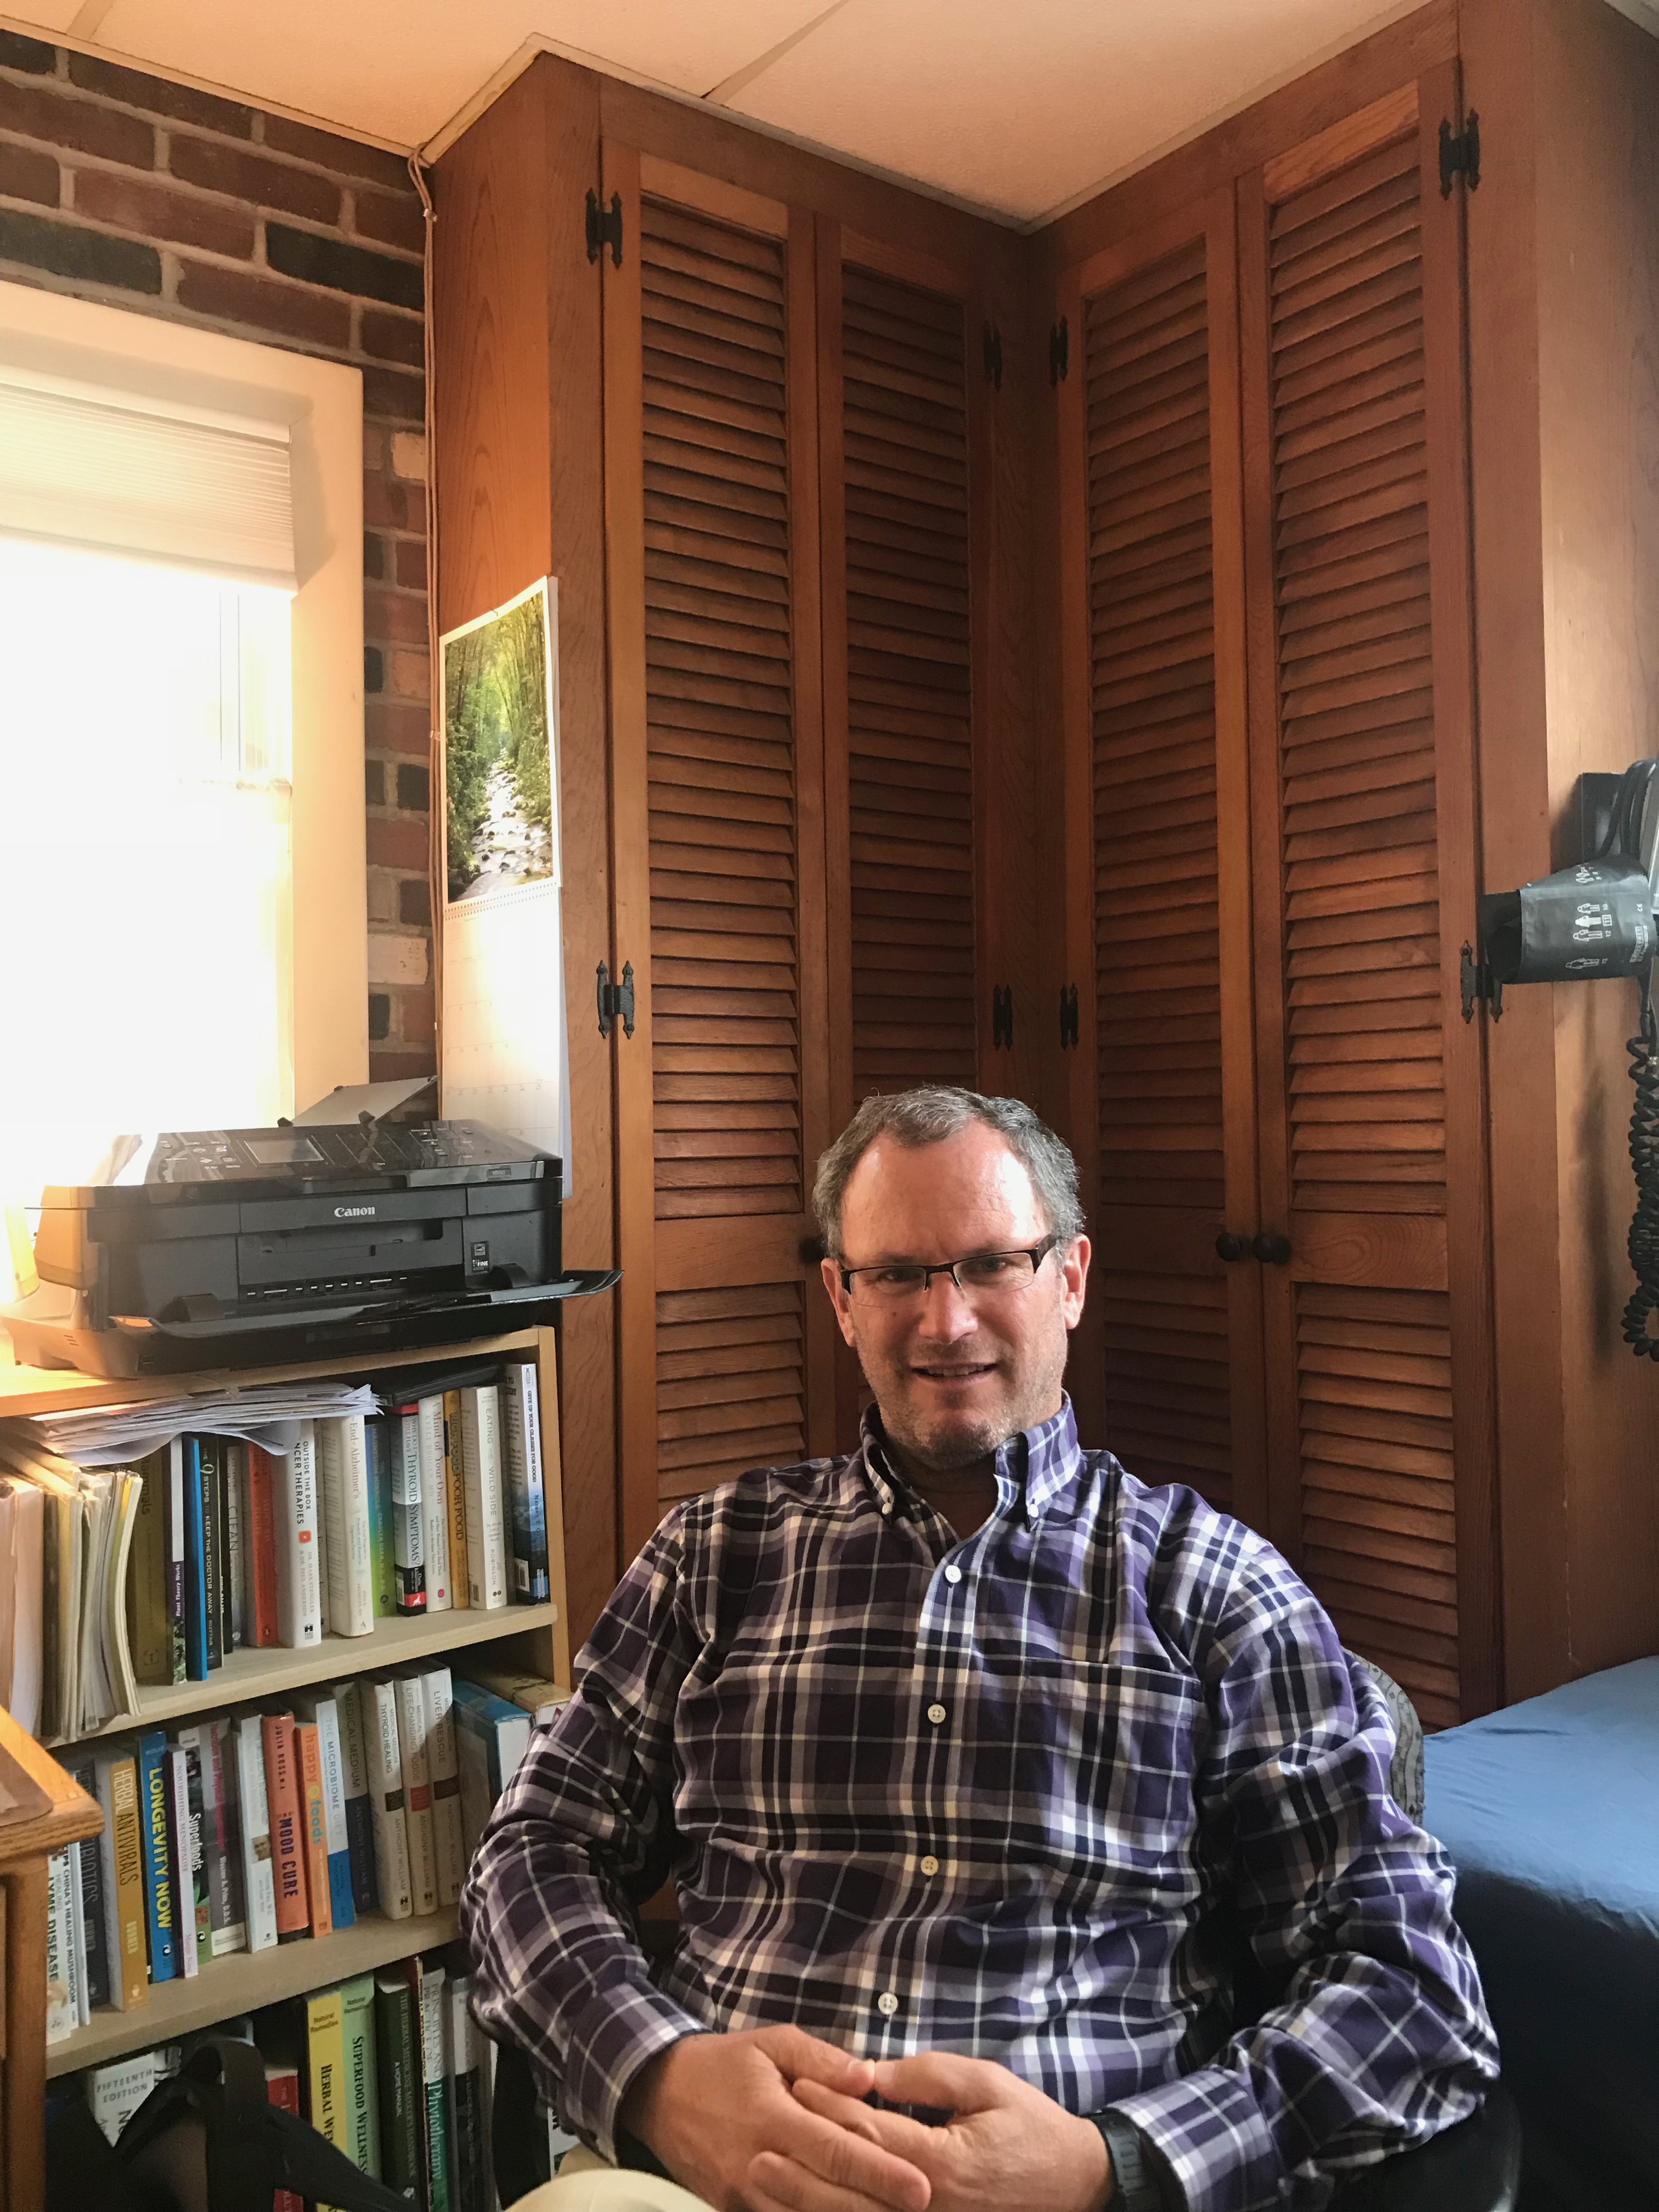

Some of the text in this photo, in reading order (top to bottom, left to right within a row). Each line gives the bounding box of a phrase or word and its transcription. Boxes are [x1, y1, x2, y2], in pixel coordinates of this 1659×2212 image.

[334, 1206, 375, 1217] Canon
[412, 1435, 418, 1446] DO
[433, 1412, 442, 1438] Mind
[434, 1441, 442, 1451] of
[449, 1412, 459, 1438] RICH
[199, 1463, 215, 1475] 9
[350, 1423, 362, 1499] End Alzheimer's
[371, 1427, 380, 1471] MAGNESIUM
[436, 1456, 444, 1479] Your
[450, 1442, 461, 1472] FOOD
[295, 1472, 305, 1525] THERAPIES
[407, 1452, 420, 1566] THYROID SYMPTOMS?
[453, 1474, 462, 1504] POOR
[454, 1508, 464, 1541] FOOD
[275, 1725, 285, 1750] JULIA
[345, 1692, 362, 1788] MEDICAL MEDIUM
[380, 1702, 393, 1773] THYROID HEALING
[405, 1687, 420, 1781] LIFE-CHANGING FOODS
[416, 1705, 424, 1733] MEDICAL
[433, 1690, 446, 1764] LIVER RESCUE
[304, 1734, 317, 1782] happy
[327, 1741, 340, 1811] MICROBIOME
[113, 1768, 139, 1886] HERBAL ANTIVIRALS
[149, 1767, 169, 1876] LONGEVITY
[175, 1765, 189, 1872] NOURISHING MENOPAUSE
[309, 1800, 324, 1844] foods
[332, 1813, 341, 1836] DIET
[394, 1818, 404, 1854] ANTHONY
[189, 1813, 204, 1872] Superfoods
[279, 1818, 298, 1899] MOOD CURE
[419, 1815, 431, 1888] ANTHONY WILLIAM
[63, 1869, 71, 1906] CHINA'S
[155, 1881, 172, 1928] NOW
[65, 1908, 75, 1946] HEALING
[48, 1918, 59, 1982] DISEASE
[310, 2020, 339, 2034] Remedies
[314, 2011, 335, 2024] Natural
[401, 2012, 410, 2046] HERBAL
[430, 1983, 442, 2078] PRINCIPLES AND
[97, 2069, 153, 2093] FIFTEENTH
[103, 2083, 148, 2103] EDITION
[321, 2063, 334, 2115] HERBAL
[353, 2036, 365, 2109] SUPERFOOD
[427, 2083, 445, 2180] Phytotherapy
